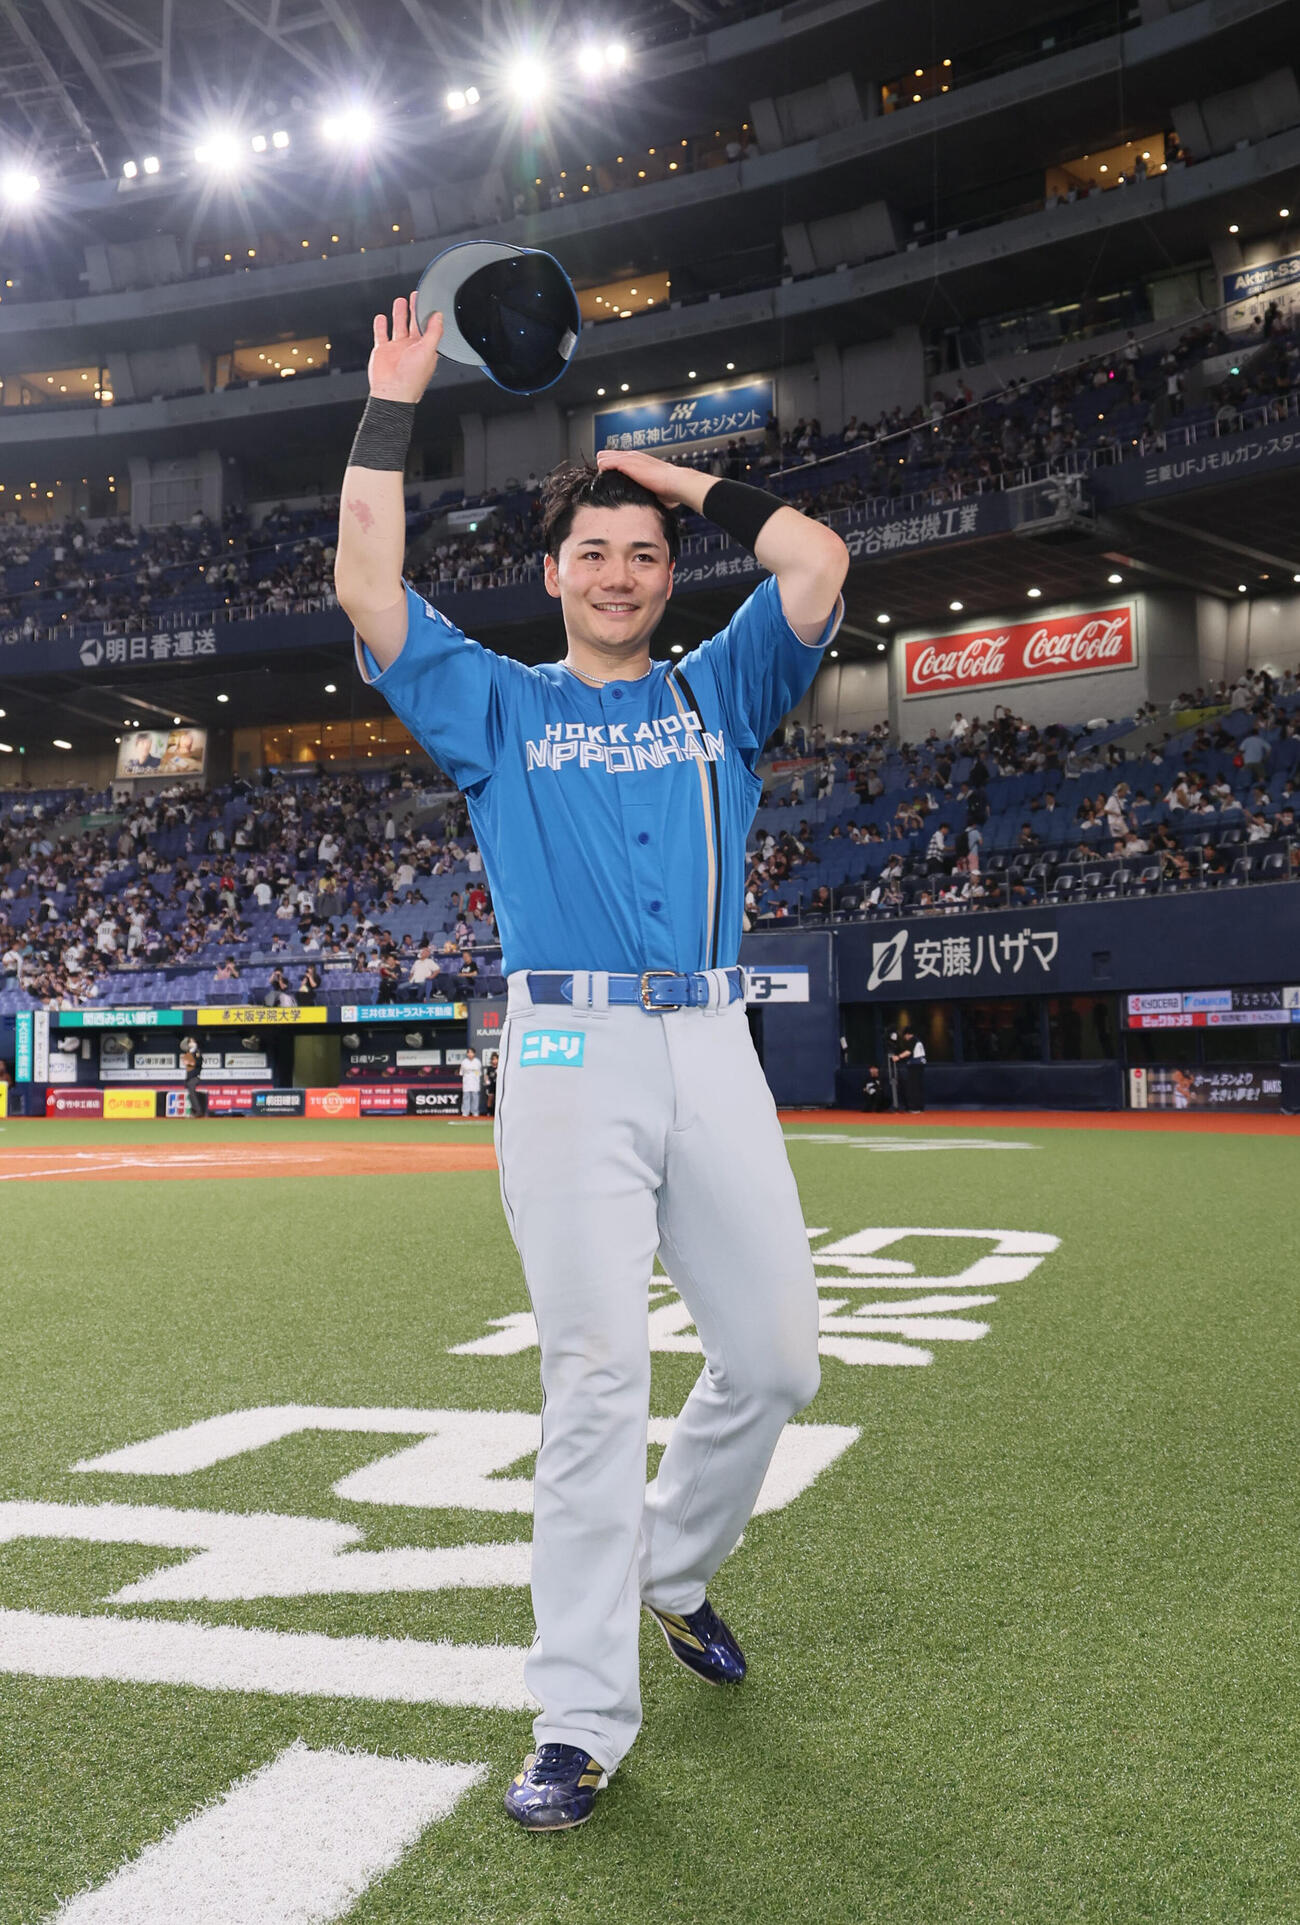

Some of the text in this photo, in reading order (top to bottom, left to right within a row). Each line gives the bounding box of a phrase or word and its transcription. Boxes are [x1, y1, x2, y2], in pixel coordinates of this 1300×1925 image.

[606, 409, 760, 449] 阪急阪神ビルマネジメント
[106, 628, 216, 663] 明日香運送
[545, 710, 703, 744] HOKKAIDO
[913, 928, 1059, 979] 安藤ハザマ
[83, 1011, 158, 1025] 関西みらい銀行
[233, 1009, 301, 1022] 大阪学院大学
[361, 1006, 453, 1019] 三井住友トラスト不動産
[523, 1036, 580, 1060] ニトリ
[350, 1053, 390, 1064] 日産リーフ
[1195, 1073, 1253, 1088] ホームランより
[415, 1094, 459, 1105] SONY
